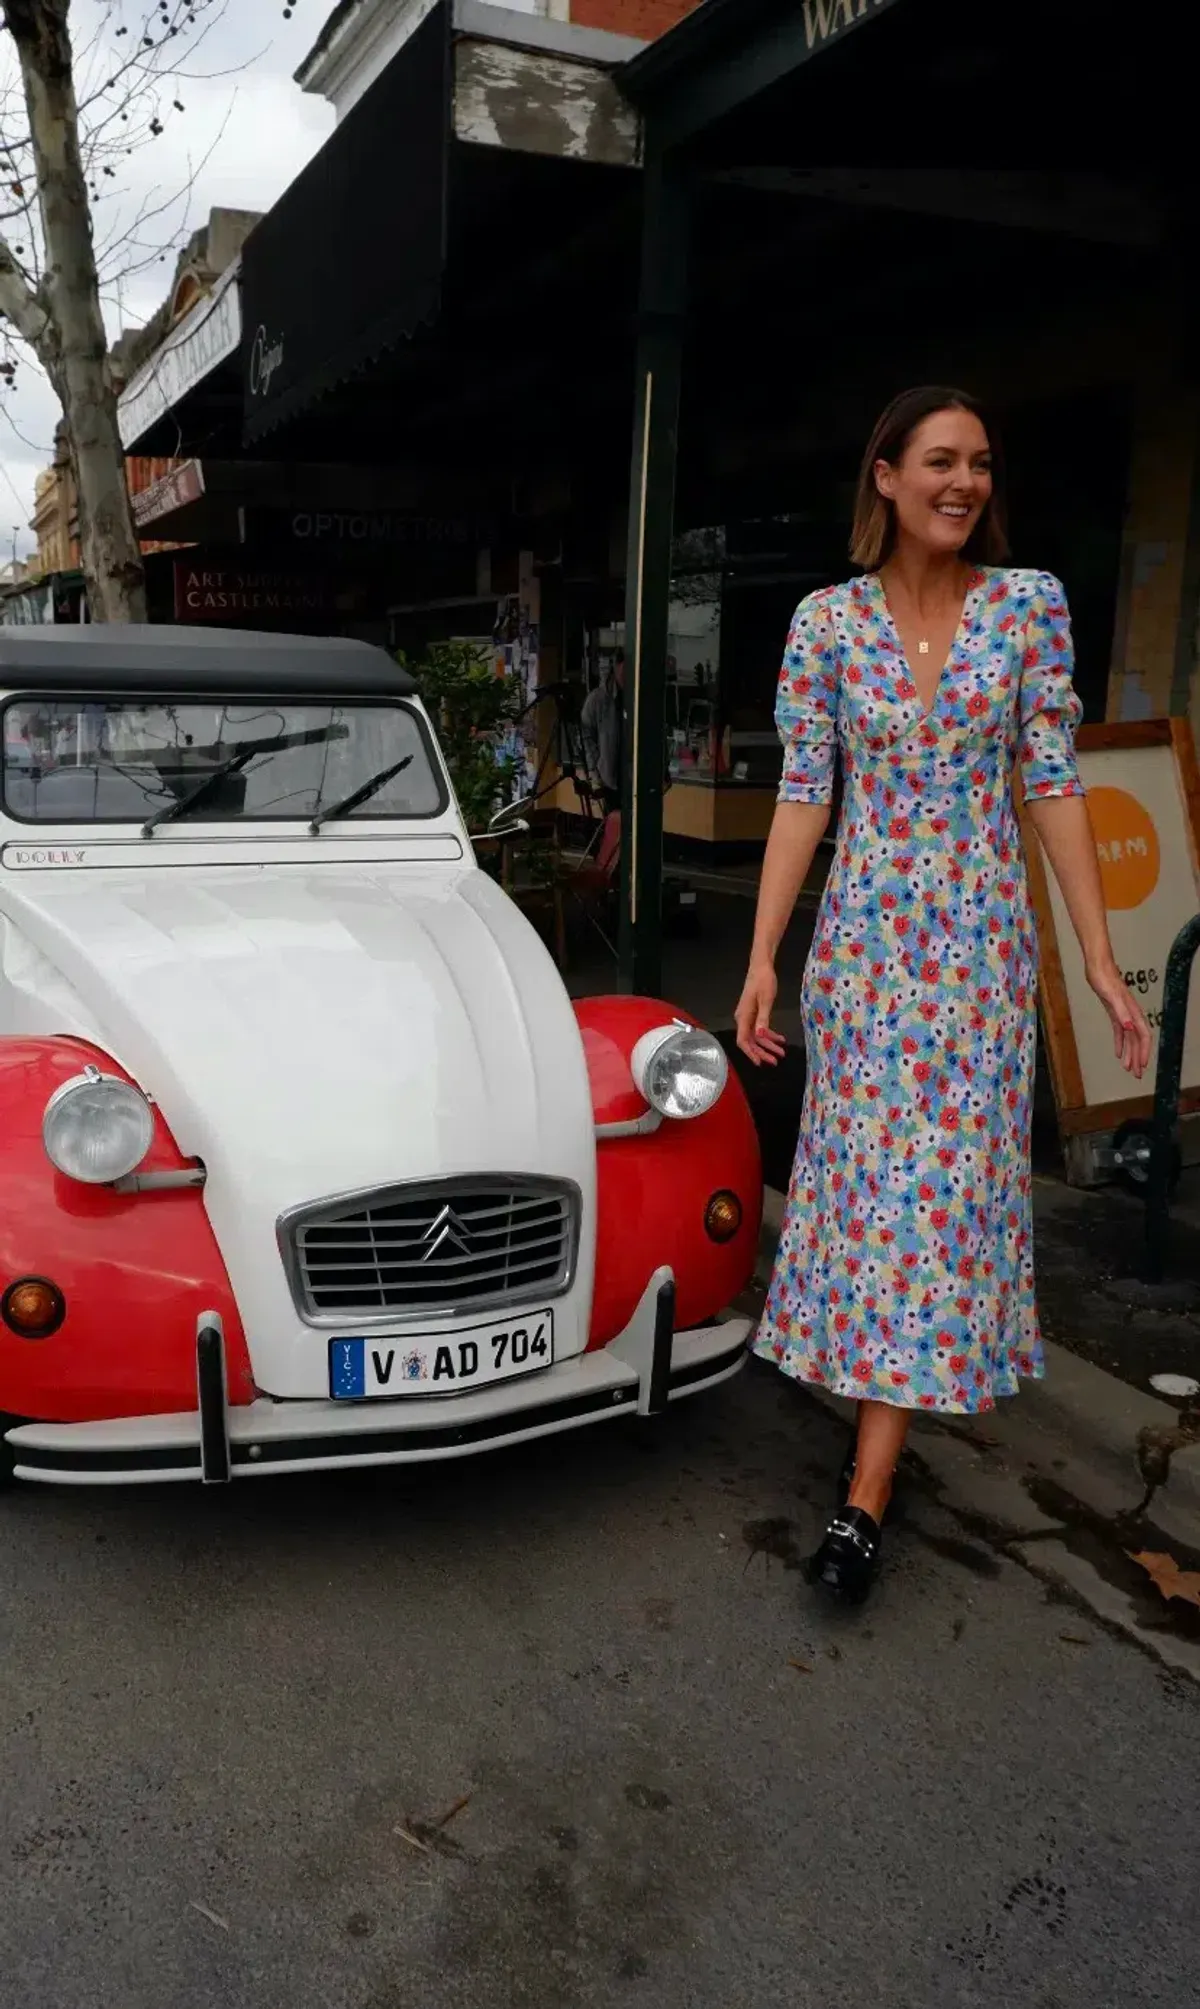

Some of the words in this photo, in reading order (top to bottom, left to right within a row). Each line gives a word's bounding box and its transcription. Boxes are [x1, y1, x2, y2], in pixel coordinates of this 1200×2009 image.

[186, 571, 227, 587] ART
[15, 850, 86, 864] DOLLY
[1119, 968, 1158, 994] age
[343, 1344, 351, 1370] VIC
[372, 1350, 395, 1384] V
[433, 1342, 478, 1380] AD
[491, 1323, 547, 1369] 704
